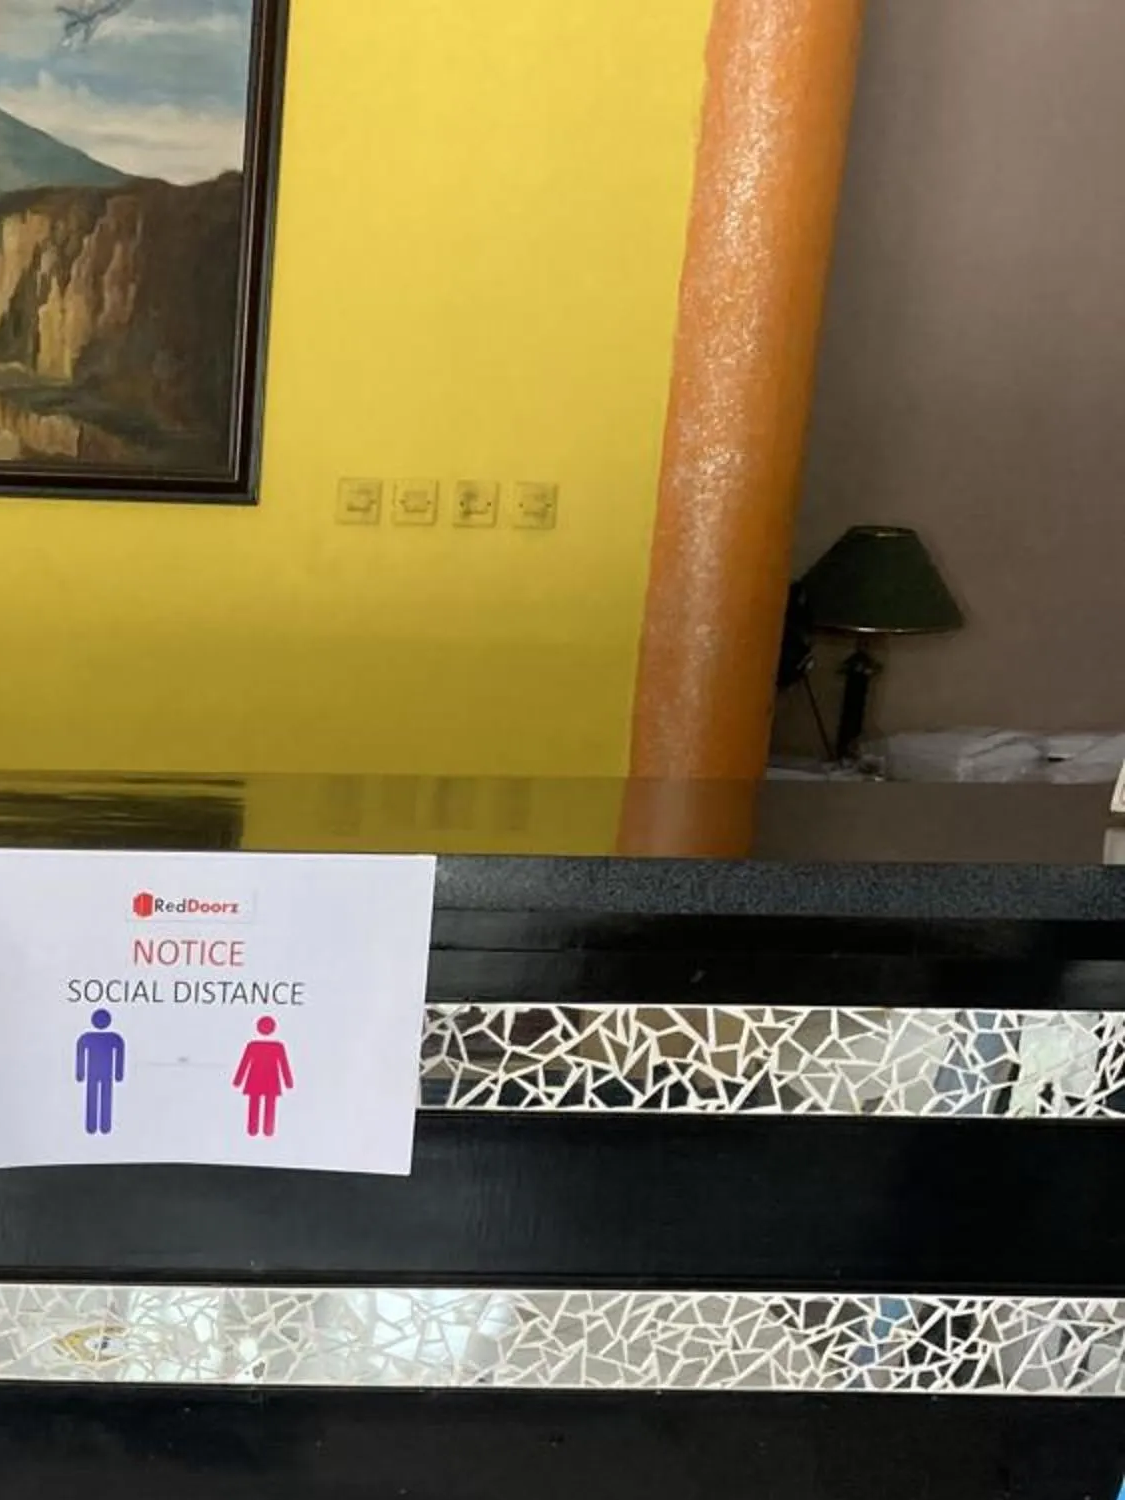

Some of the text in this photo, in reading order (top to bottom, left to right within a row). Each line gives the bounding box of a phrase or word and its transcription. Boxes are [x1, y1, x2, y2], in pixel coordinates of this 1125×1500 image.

[154, 897, 239, 913] RedDoorz
[133, 939, 245, 967] NOTICE
[66, 979, 305, 1006] SOCIAL DISTANCE
